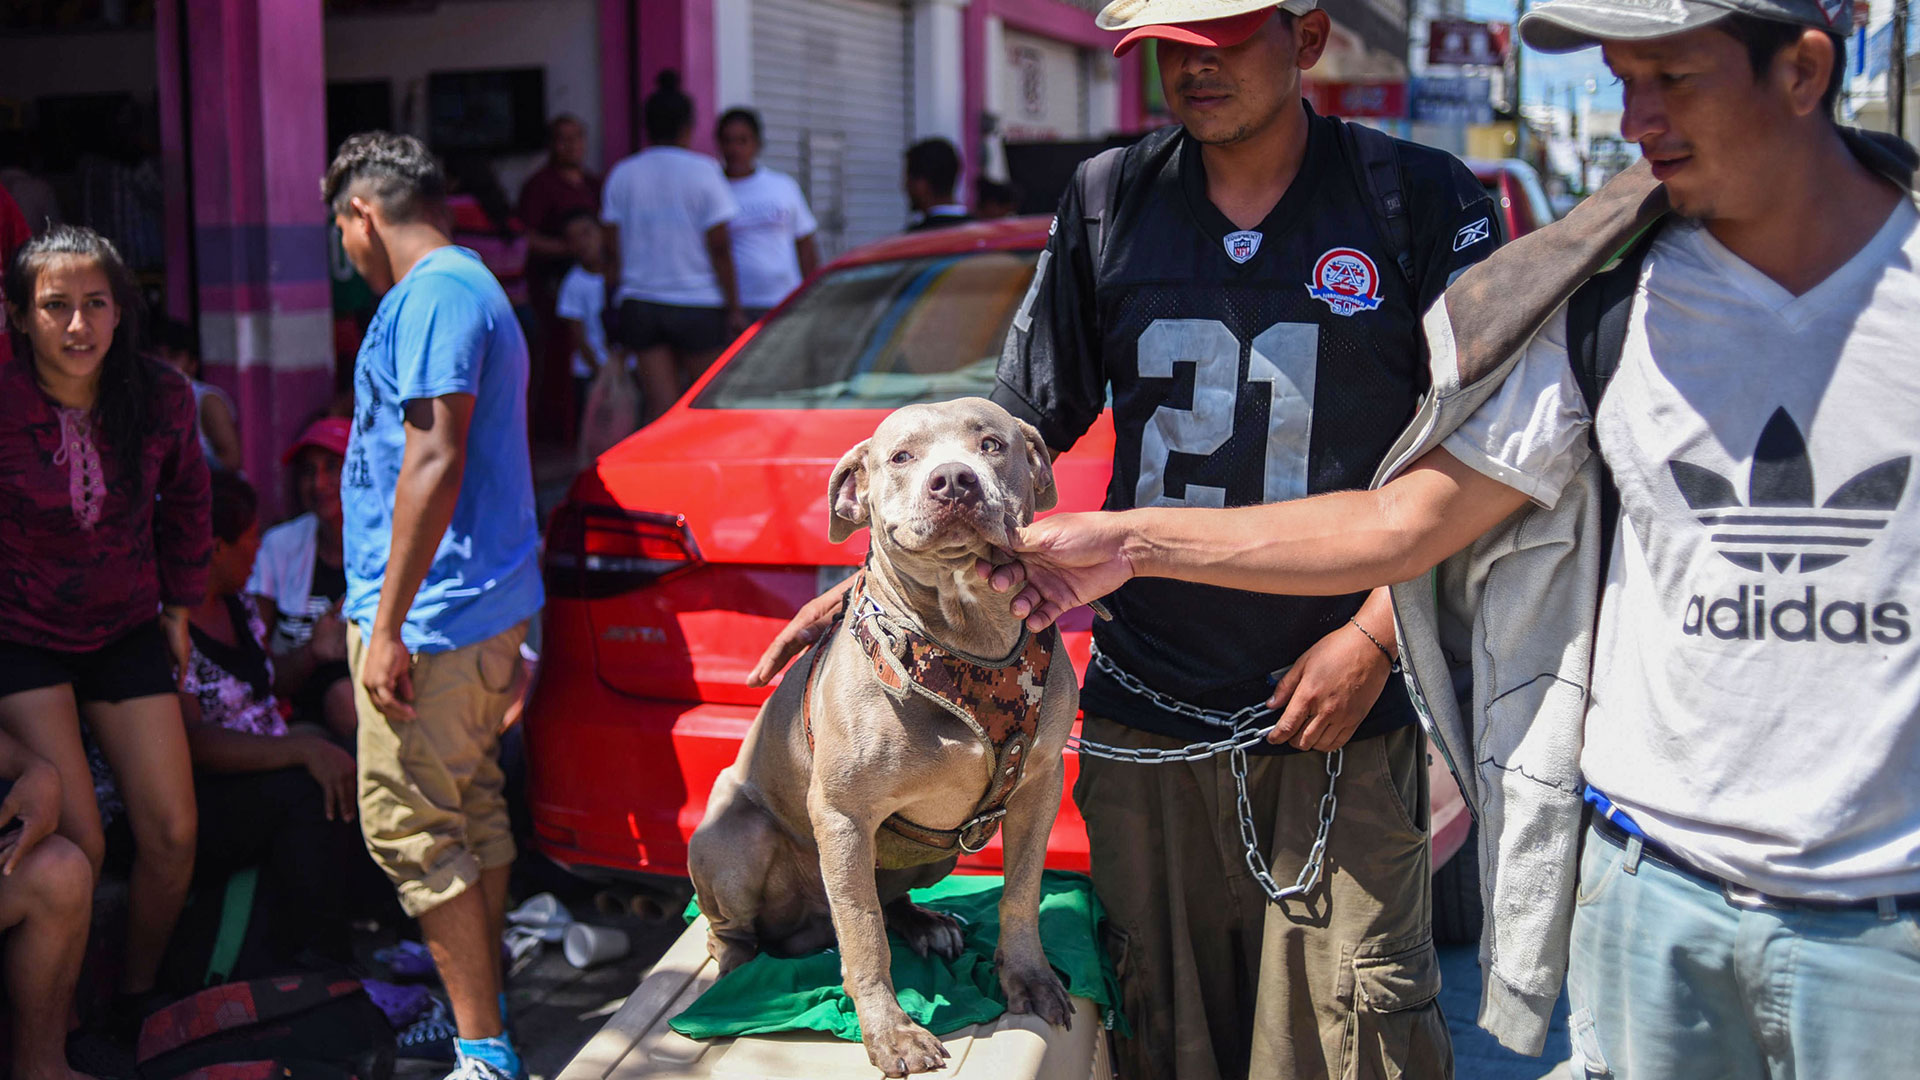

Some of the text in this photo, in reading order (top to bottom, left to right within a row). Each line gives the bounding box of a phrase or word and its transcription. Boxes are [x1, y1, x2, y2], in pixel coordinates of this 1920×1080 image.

[1235, 246, 1251, 257] NFL
[1134, 318, 1319, 508] 21
[1682, 584, 1912, 645] adidas
